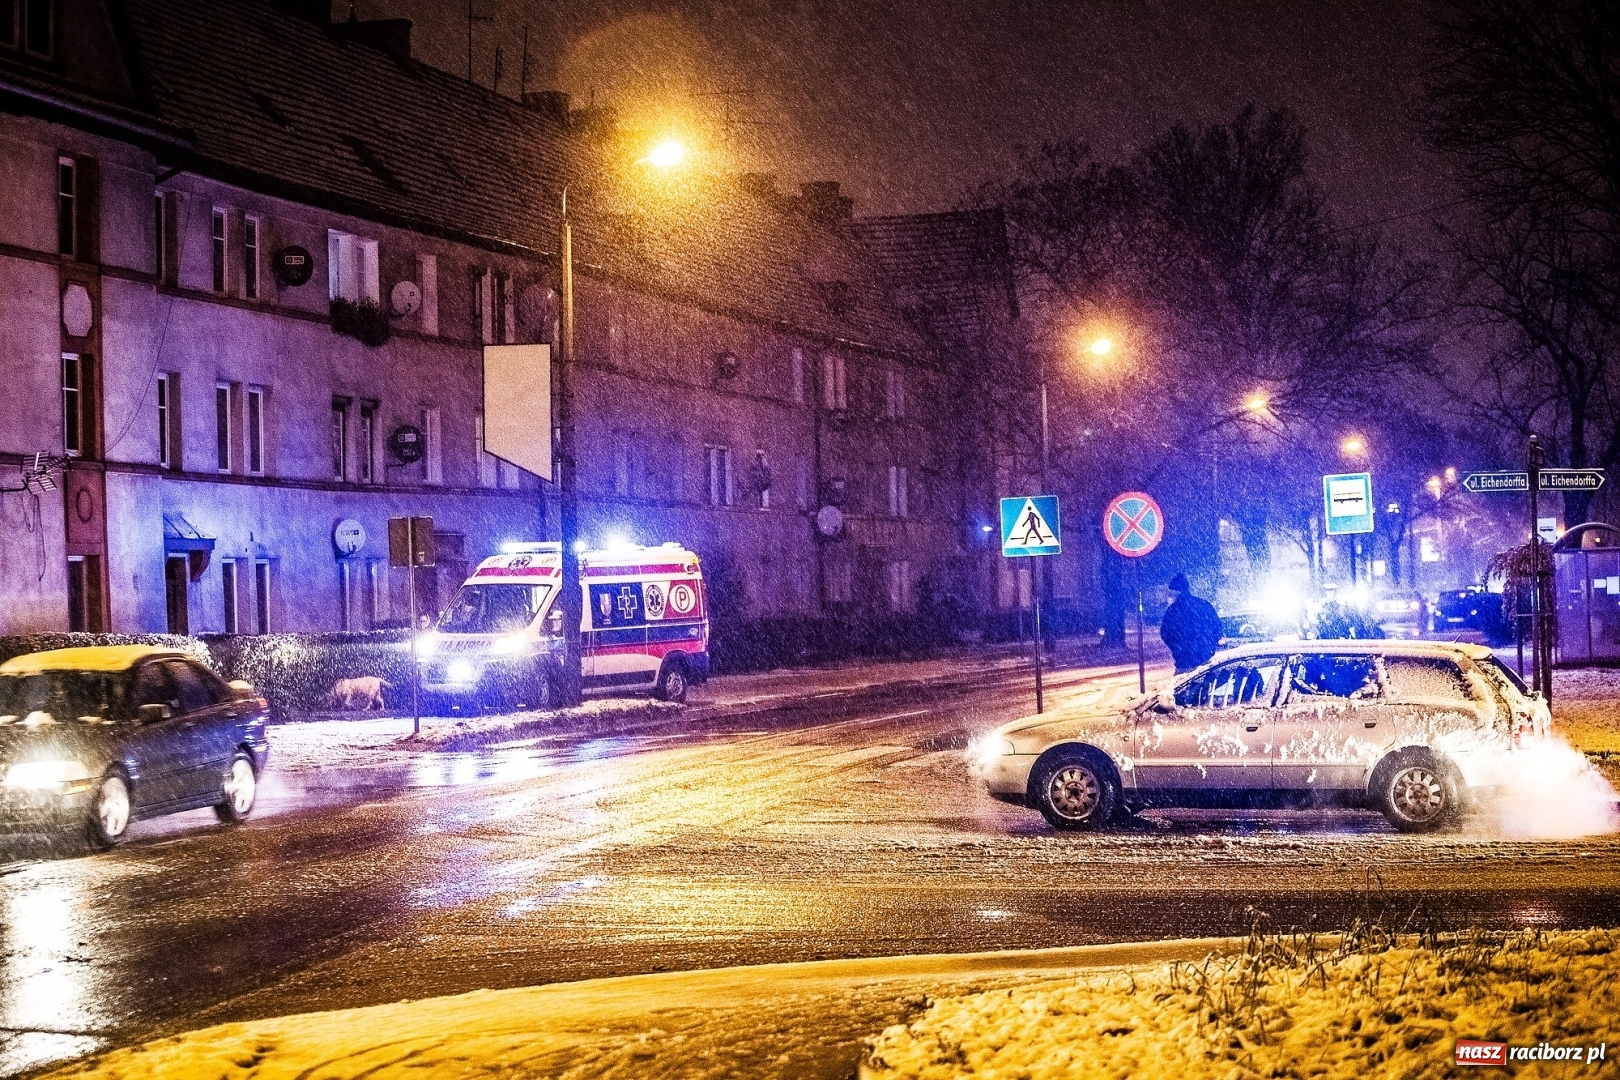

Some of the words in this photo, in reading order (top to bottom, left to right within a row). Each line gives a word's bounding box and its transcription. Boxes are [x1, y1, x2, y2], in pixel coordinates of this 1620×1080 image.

[1470, 476, 1480, 488] ul.
[1481, 476, 1525, 488] Eichendorffa
[1540, 474, 1550, 486] ul.
[1551, 474, 1596, 486] Eichendorffa
